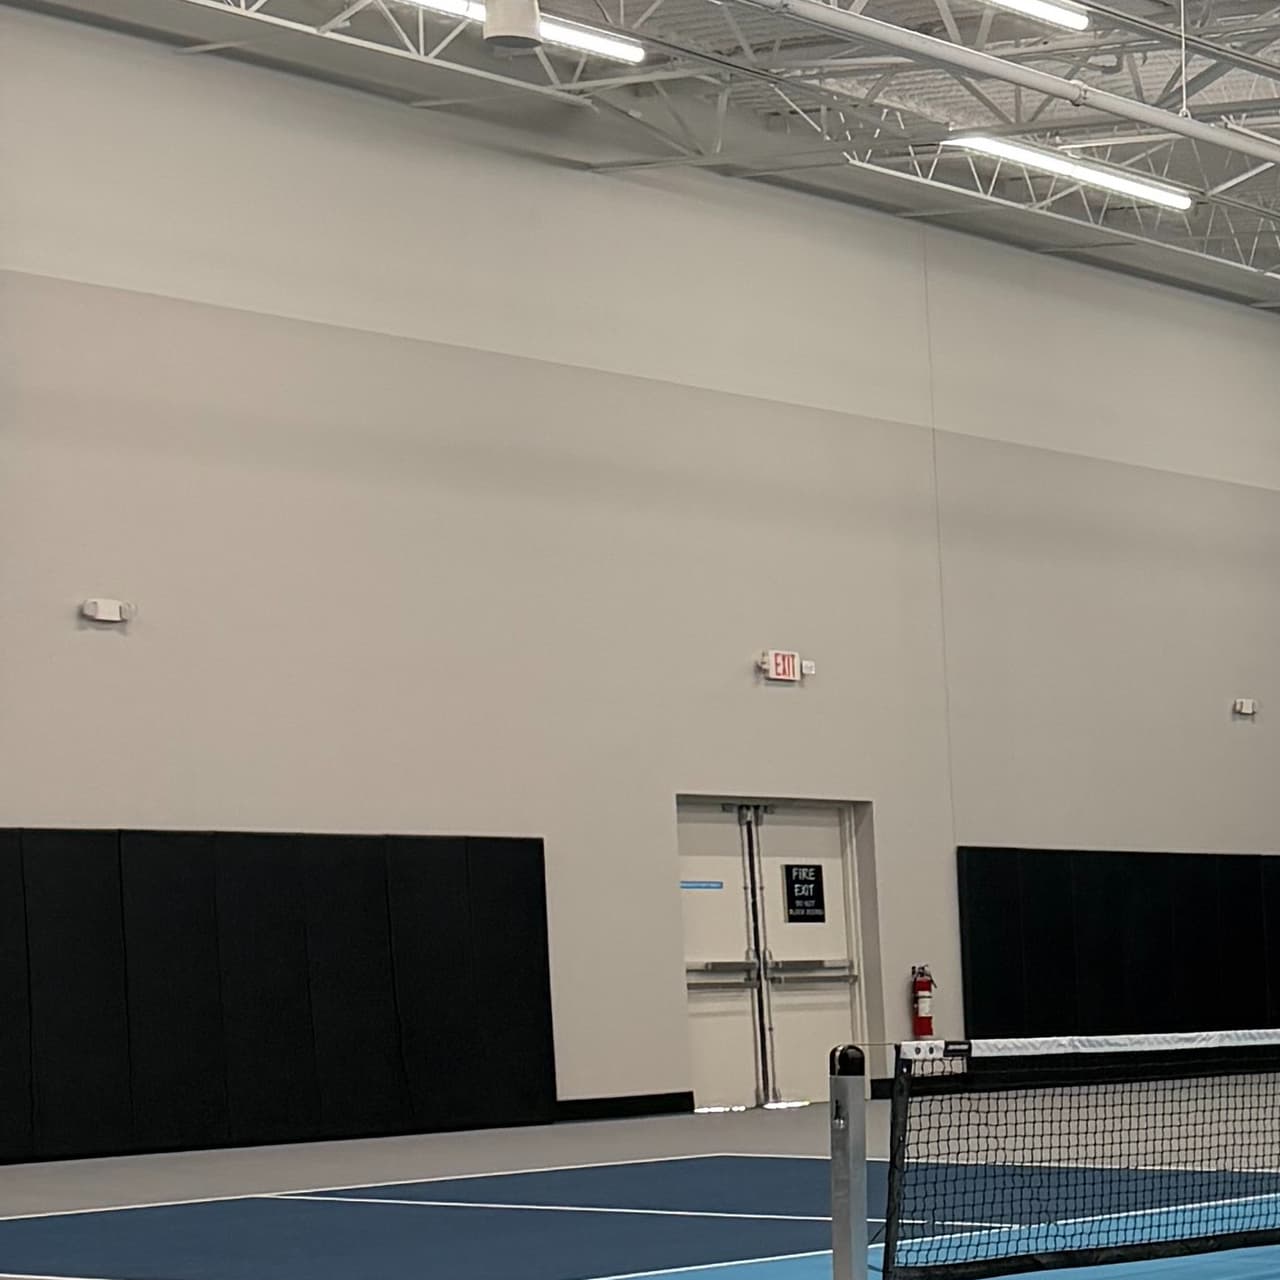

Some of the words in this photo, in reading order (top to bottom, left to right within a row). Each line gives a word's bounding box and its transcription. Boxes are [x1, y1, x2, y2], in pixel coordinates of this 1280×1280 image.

[774, 652, 796, 678] EXIT
[792, 867, 816, 880] FIRE
[794, 884, 814, 896] EXIT
